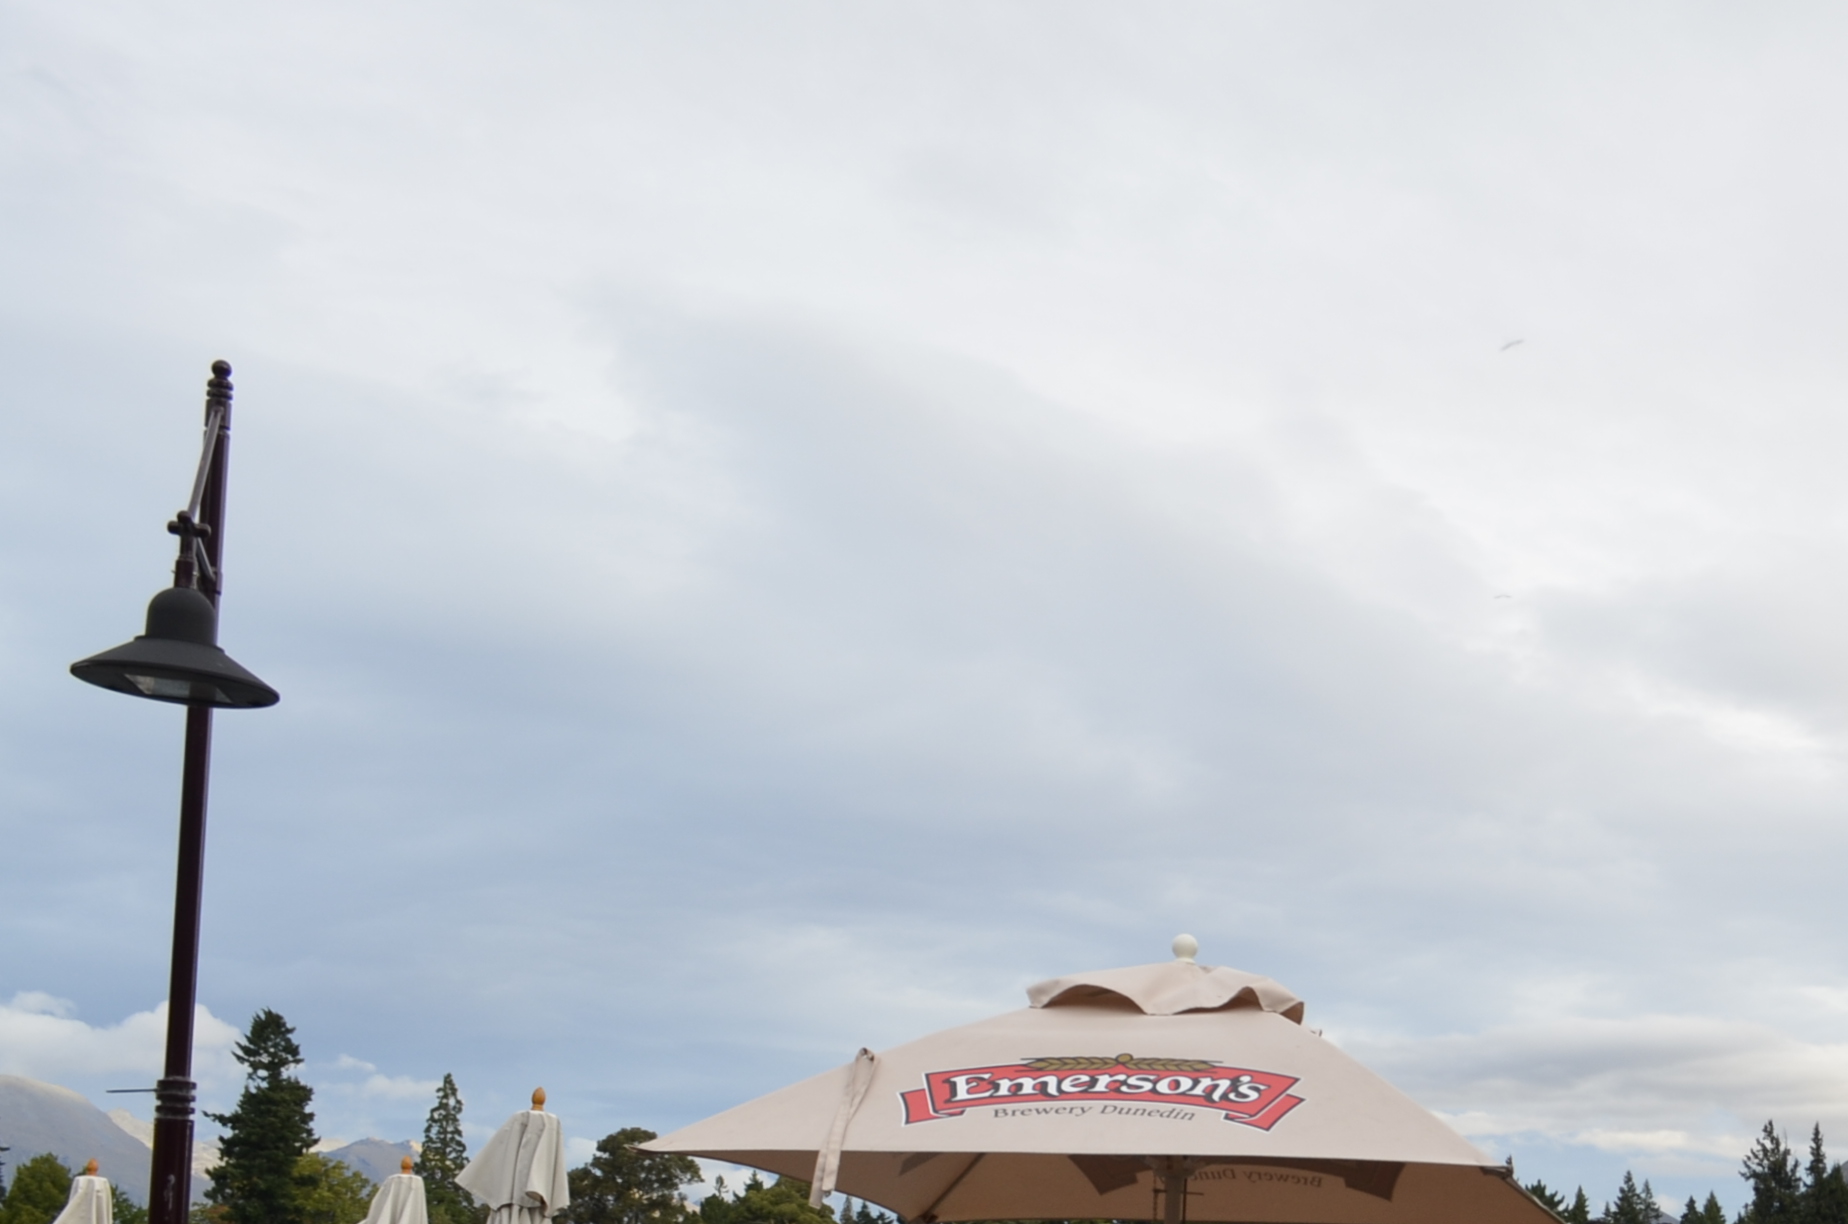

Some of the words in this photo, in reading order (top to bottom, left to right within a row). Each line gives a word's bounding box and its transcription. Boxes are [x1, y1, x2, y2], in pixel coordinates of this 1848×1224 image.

[948, 1071, 1269, 1103] Emerson's
[991, 1103, 1095, 1119] Brewery
[1099, 1103, 1196, 1121] Dunedin
